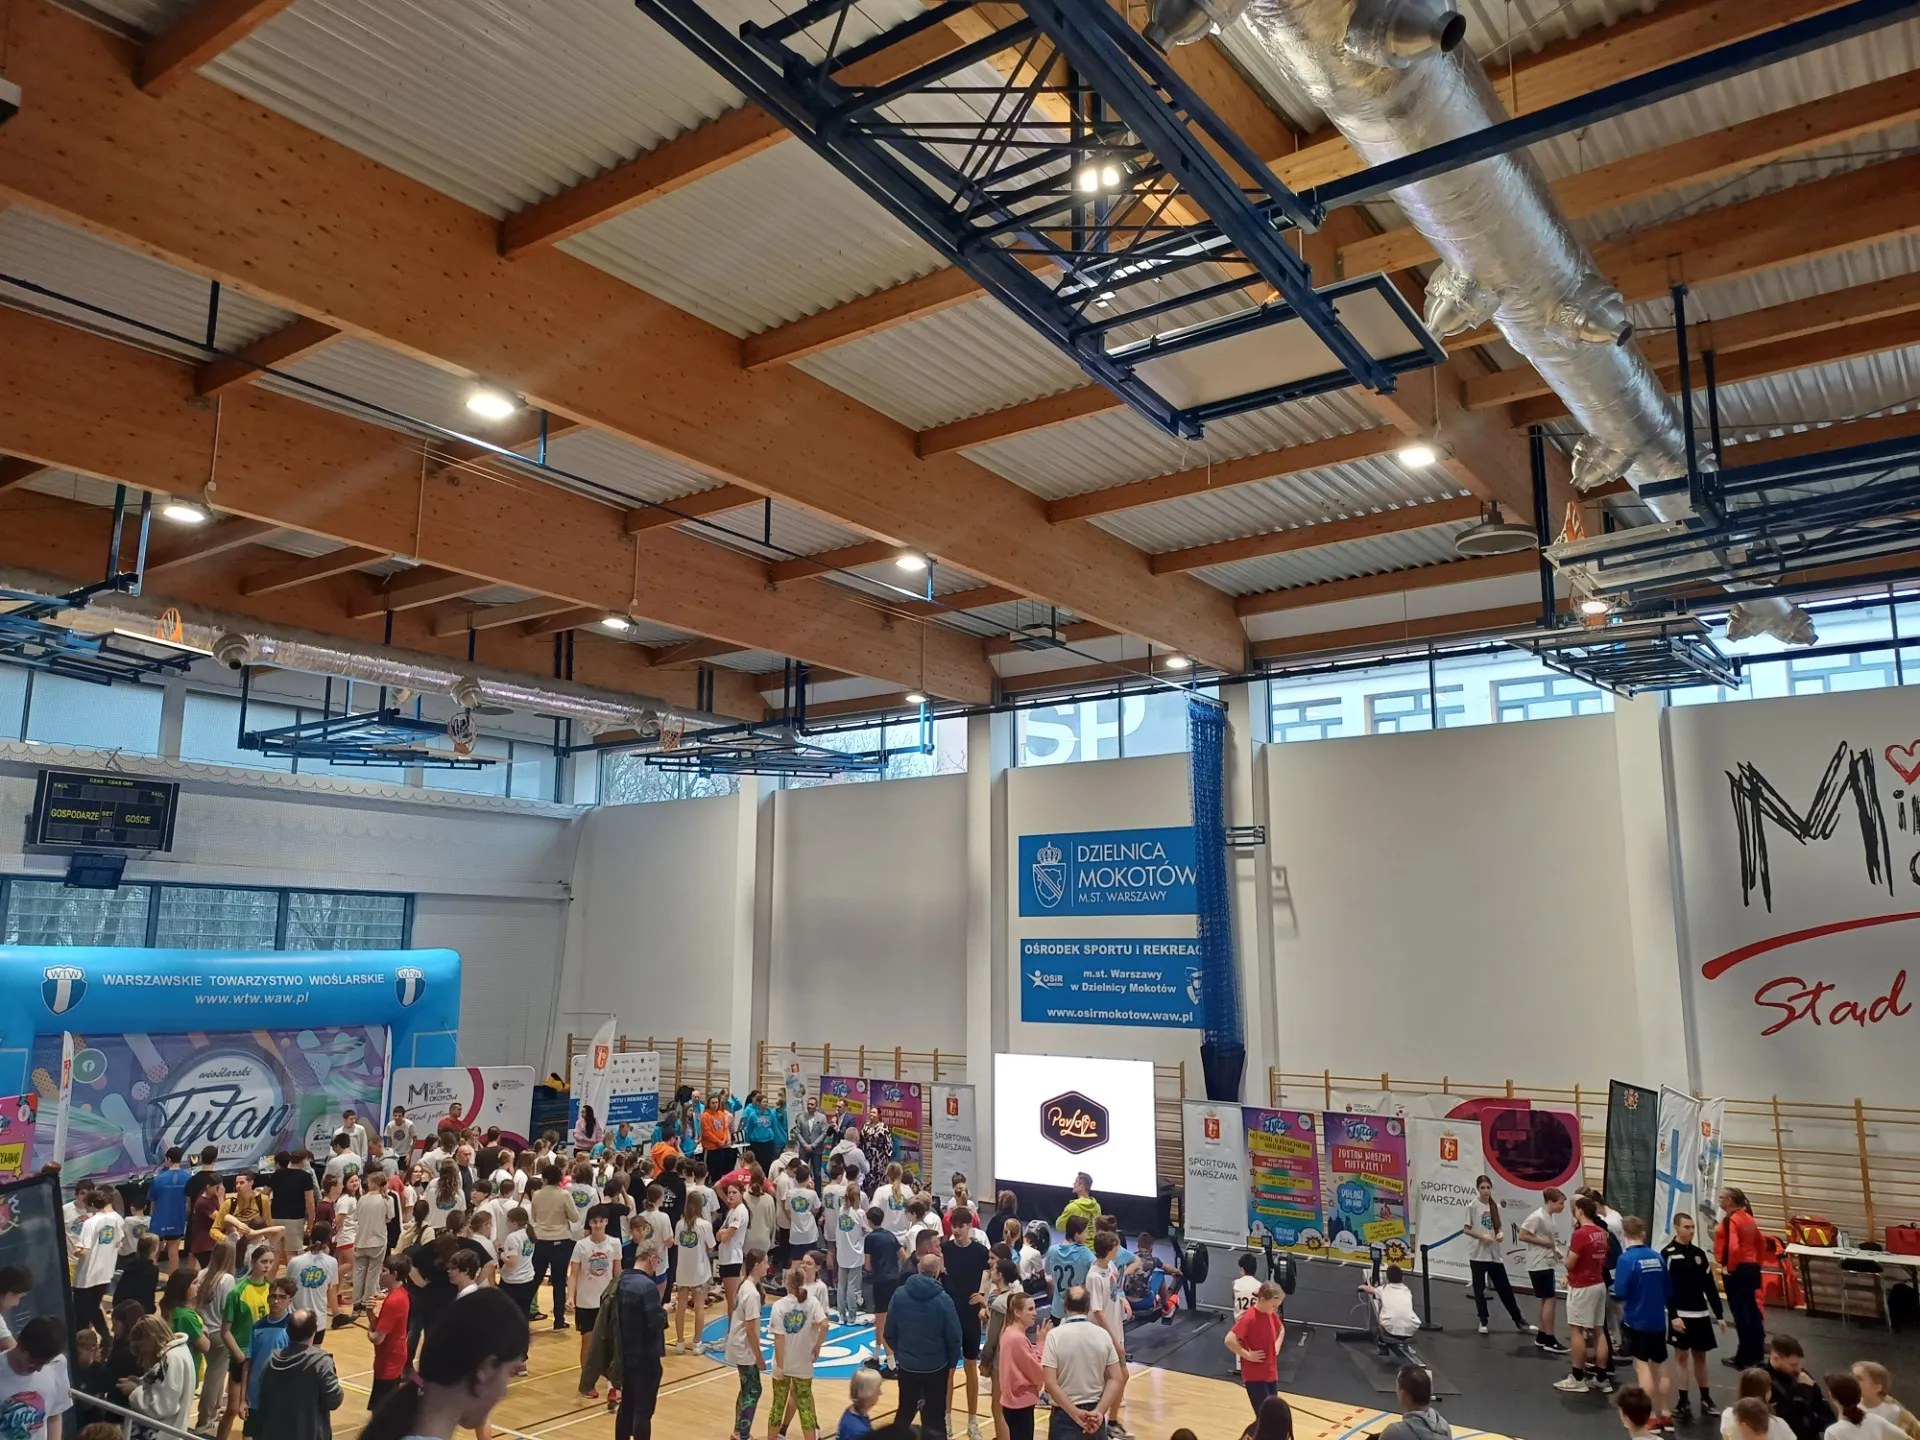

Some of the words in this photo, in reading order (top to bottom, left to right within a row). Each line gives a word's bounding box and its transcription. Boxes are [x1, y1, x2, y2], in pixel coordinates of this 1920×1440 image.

[51, 808, 100, 821] GOSPODARZE
[125, 813, 151, 824] GOŚCIE
[1078, 842, 1167, 863] DZIELNICA
[1078, 860, 1197, 889] MOKOTÓW
[1106, 891, 1168, 902] WARSZAWY
[1024, 943, 1080, 955] OŚRODEK
[1084, 944, 1132, 956] SPORTU
[50, 969, 80, 979] WTW
[103, 974, 203, 987] WARSZAWSKIE
[209, 975, 303, 987] TOWARZYSTWO
[309, 973, 385, 986] WIOŚLARSKIE
[399, 969, 421, 979] WTW
[1083, 970, 1108, 979] m.st.
[1110, 969, 1163, 980] Warszawy
[1082, 982, 1127, 995] Dzielnicy
[1129, 983, 1177, 994] Mokotów
[195, 992, 309, 1006] www.wtw.waw.pl
[1047, 1009, 1194, 1023] www.osirmokotow.waw.pl
[198, 1066, 252, 1080] wioślarski
[149, 1084, 291, 1158] Tytan
[935, 1132, 971, 1143] SPORTOWA
[216, 1143, 255, 1155] ARSZAWY
[934, 1141, 972, 1152] WARSZAWA
[1188, 1157, 1237, 1170] SPORTOWA
[1188, 1168, 1239, 1181] WARSZAWA
[1421, 1181, 1477, 1196] SPORTOWA
[1421, 1193, 1474, 1207] WARSZAW
[1053, 1265, 1075, 1293] 22
